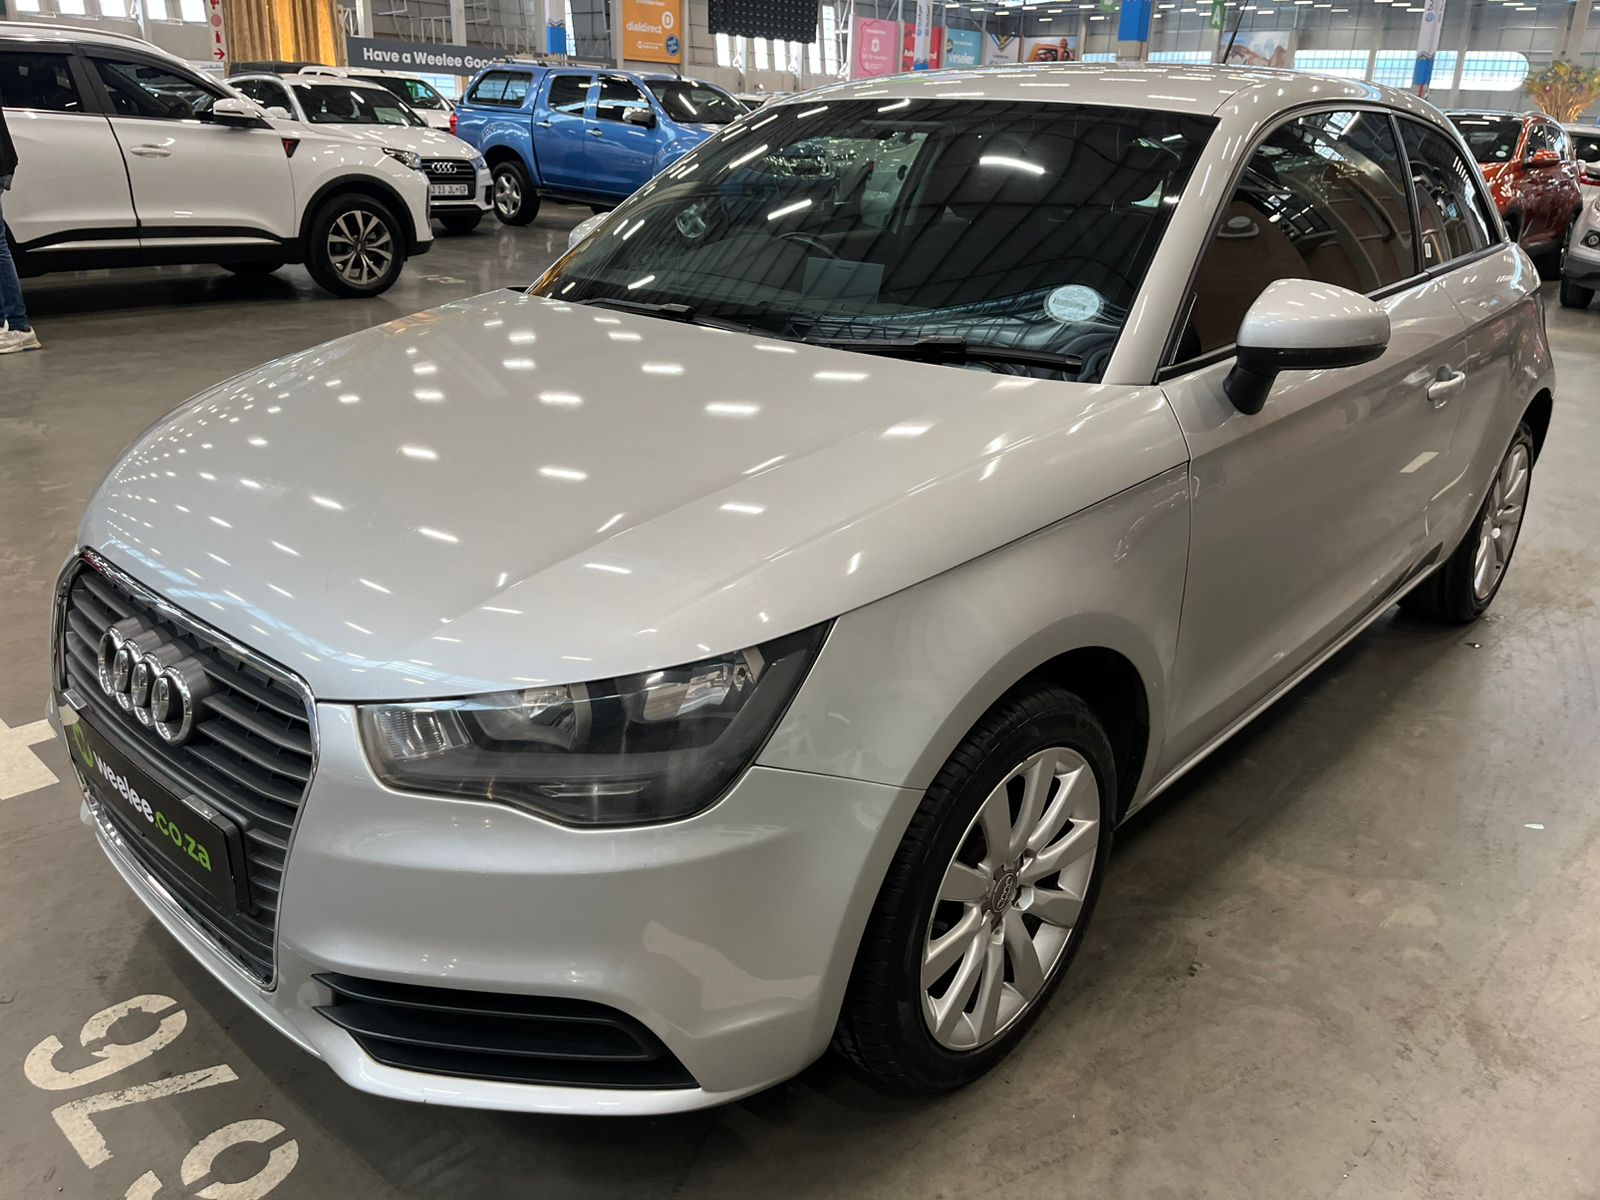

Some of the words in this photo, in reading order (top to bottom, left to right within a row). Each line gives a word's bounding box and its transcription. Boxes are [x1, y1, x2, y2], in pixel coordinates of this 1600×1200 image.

[363, 47, 400, 62] Have
[402, 53, 411, 63] a
[413, 51, 462, 67] Weelee
[93, 750, 212, 872] weelee.co.za
